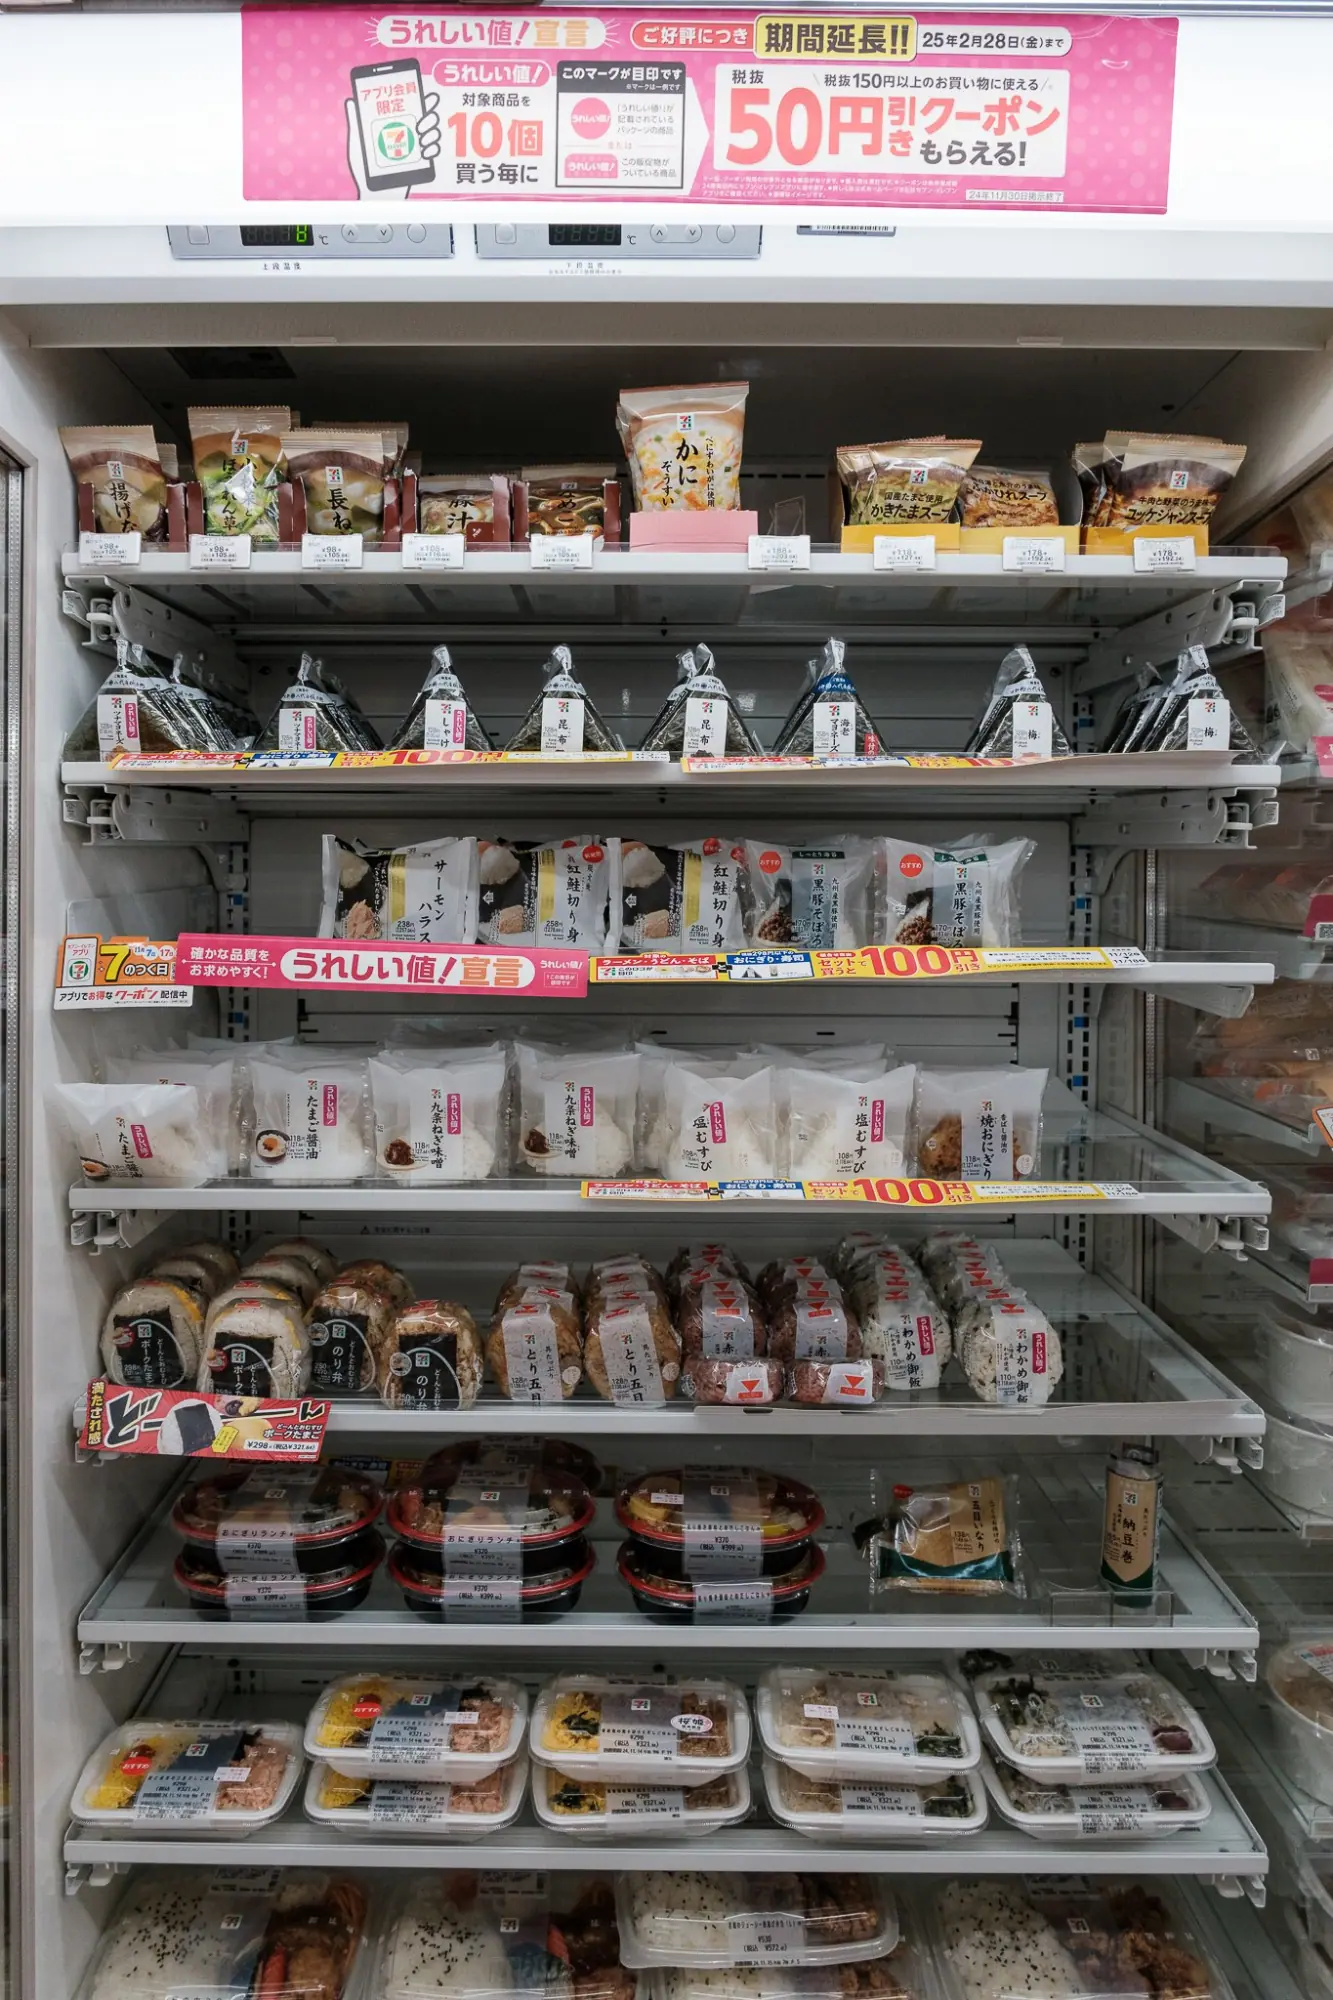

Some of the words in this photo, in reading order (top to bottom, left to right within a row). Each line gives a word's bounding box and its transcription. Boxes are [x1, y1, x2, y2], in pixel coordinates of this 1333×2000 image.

[643, 26, 748, 45] ご好評につき
[765, 22, 909, 55] 期間延長!!
[923, 31, 1065, 49] 25年2月28日(金)まで
[444, 64, 541, 83] うれしい値!
[562, 67, 682, 81] このマークが目印です
[732, 69, 764, 84] 税抜
[824, 73, 1038, 92] 税抜150円以上のお買い物に使える
[360, 84, 417, 101] アプリ会員
[462, 93, 531, 108] 対象商品を
[376, 99, 405, 116] 限定
[617, 115, 674, 124] 記載されている
[919, 96, 1061, 137] クーポン
[447, 112, 543, 158] 10個
[726, 88, 883, 166] 50円
[888, 97, 915, 156] 引き
[919, 140, 1027, 166] もらえる!
[456, 164, 538, 185] 買う毎に
[969, 190, 1063, 202] 24年11月30日掲示終了
[676, 437, 698, 486] かに
[661, 460, 675, 507] ぞうすい
[884, 491, 944, 503] 国産たまご使用
[441, 717, 450, 747] しゃけ
[558, 719, 569, 745] 昆布
[699, 720, 711, 746] 昆布
[830, 719, 840, 752] マヨネーズ
[840, 719, 850, 736] 海老
[1028, 727, 1038, 741] 梅
[1204, 726, 1214, 740] 梅
[759, 858, 781, 867] おすすめ
[900, 861, 922, 869] おすすめ
[434, 859, 447, 921] サーモン
[566, 864, 581, 943] 紅鮭切り身
[712, 864, 728, 948] 紅鮭切り身
[812, 878, 825, 947] 黒豚そぼろ
[831, 877, 840, 930] 九州産黒豚使用
[419, 902, 432, 943] ハラス
[100, 944, 130, 983] 7
[124, 962, 168, 976] のつく日
[190, 947, 269, 961] 確かな品質を
[540, 960, 583, 970] うれしい値!
[602, 956, 710, 966] ラーメン・うどん・そば
[733, 955, 805, 964] おにぎり・寿司
[818, 959, 867, 967] セットで
[190, 964, 268, 979] お求めやすく!
[294, 952, 523, 987] うれしい値!宣言
[821, 968, 856, 976] 買うと
[956, 963, 981, 972] 引き
[306, 1095, 318, 1160] たまご醤油
[431, 1101, 443, 1169] 九条ねぎ味噌
[564, 1094, 577, 1159] 九条ねぎ味噌
[1000, 1113, 1008, 1153] 香ばし醤油の
[692, 1116, 712, 1172] 塩むすび
[854, 1113, 869, 1173] 塩むすび
[980, 1114, 994, 1180] 焼おにぎり
[156, 1338, 167, 1385] どーんとおむすび
[332, 1346, 344, 1384] のり弁
[902, 1328, 921, 1388] わかめ御飯
[527, 1349, 542, 1402] とり五目
[624, 1349, 644, 1402] とり五目
[1016, 1342, 1029, 1403] わかめ御飯
[88, 1382, 104, 1444] 満たされ感
[263, 1429, 320, 1440] ポークたまご
[276, 1423, 322, 1431] どーんとおむすび
[222, 1529, 286, 1537] おにぎりランチ
[122, 1762, 149, 1770] おすすめ
